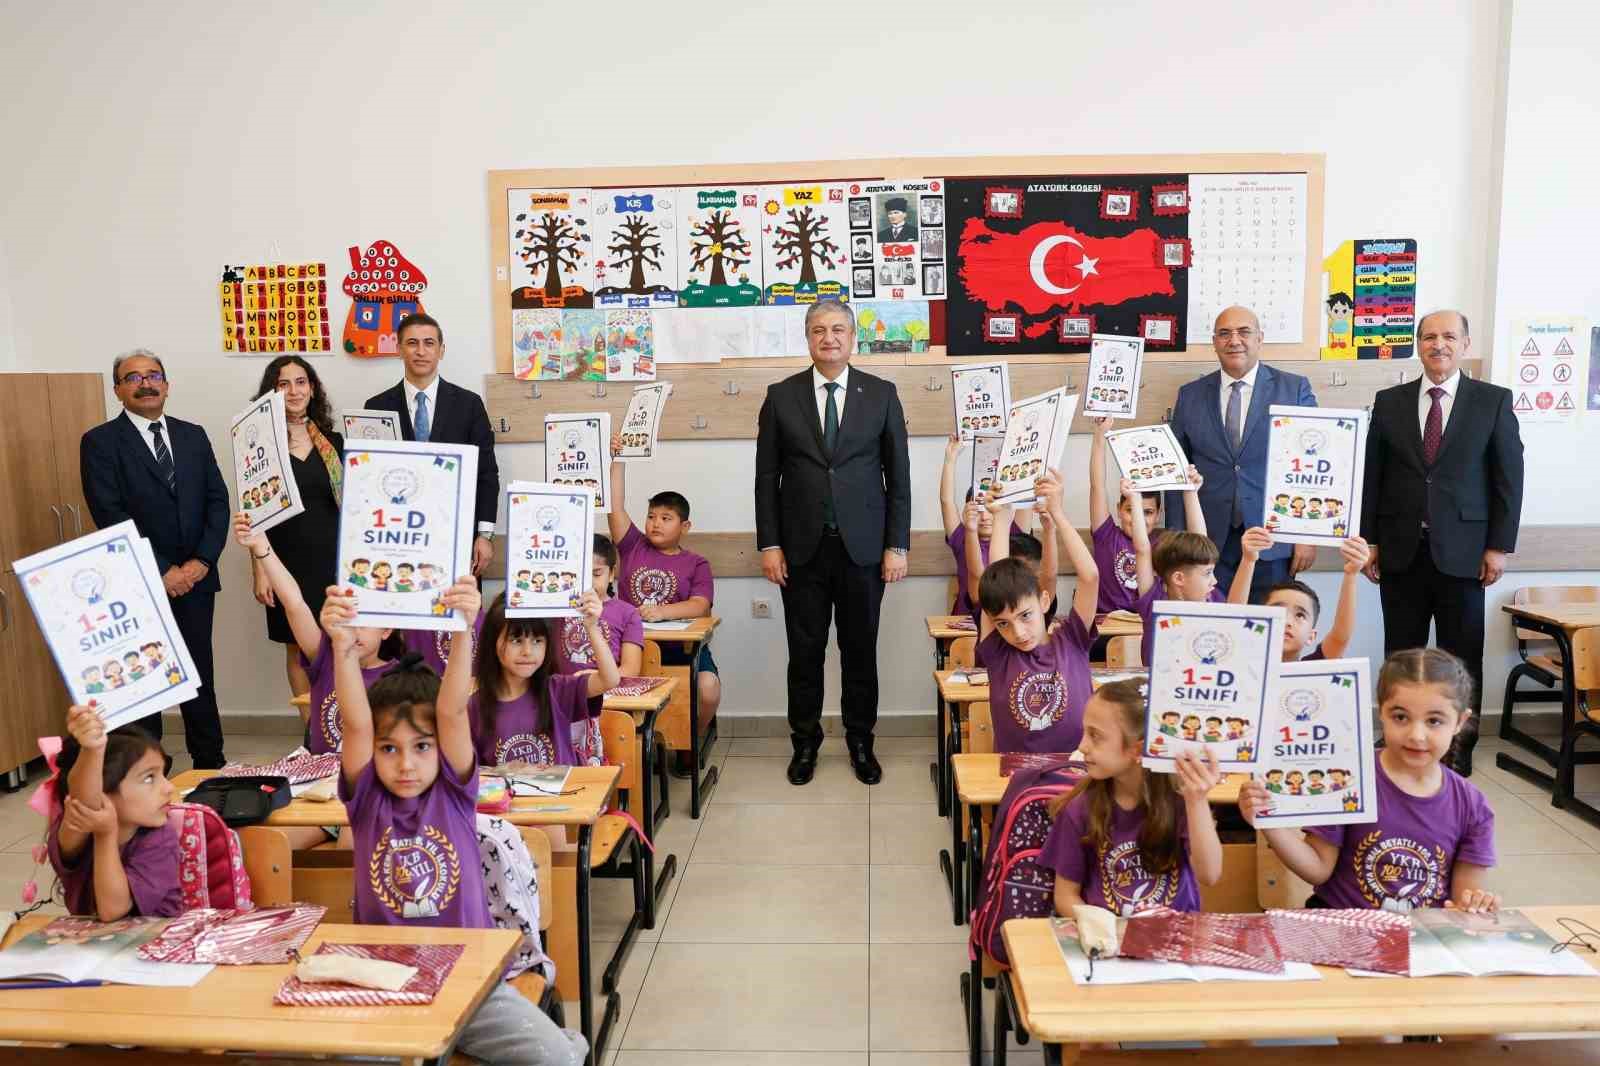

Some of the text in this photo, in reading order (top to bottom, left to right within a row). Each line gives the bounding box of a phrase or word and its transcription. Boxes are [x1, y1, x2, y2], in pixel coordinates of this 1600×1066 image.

[794, 192, 813, 200] YAZ
[626, 199, 642, 208] KIŞ
[249, 268, 256, 277] A
[269, 268, 275, 278] B
[287, 267, 295, 277] C
[224, 285, 231, 294] D
[248, 285, 254, 294] E
[270, 285, 276, 294] F
[287, 283, 296, 293] G
[224, 298, 231, 308] H
[287, 296, 292, 306] J
[308, 297, 315, 306] K
[225, 312, 232, 322] L
[247, 312, 256, 322] M
[269, 312, 277, 321] N
[287, 311, 296, 321] O
[227, 327, 232, 336] P
[249, 326, 255, 336] R
[270, 325, 276, 335] S
[309, 325, 316, 334] T
[226, 340, 232, 350] U
[269, 342, 276, 351] V
[290, 339, 296, 349] Y
[311, 339, 318, 350] Z
[1102, 366, 1123, 375] 1-D
[1098, 374, 1124, 383] SINIFI
[968, 393, 990, 403] 1-D
[965, 402, 994, 410] SINIFI
[632, 410, 647, 420] 1-D
[628, 420, 647, 428] SINIFI
[1015, 432, 1039, 446] 1-D
[1010, 442, 1039, 456] SINIFI
[1131, 446, 1159, 458] 1-D
[244, 446, 265, 468] 1-D
[560, 451, 586, 462] 1-D
[1130, 452, 1164, 464] SINIFI
[243, 459, 270, 481] SINIFI
[557, 462, 589, 472] SINIFI
[1291, 458, 1331, 473] 1-D
[1285, 473, 1334, 487] SINIFI
[372, 509, 425, 529] 1-D
[364, 530, 430, 547] SINIFI
[530, 535, 565, 547] 1-D
[525, 550, 569, 561] SINIFI
[79, 600, 128, 632] 1-D
[79, 617, 140, 652] SINIFI
[1182, 668, 1235, 687] 1-D
[1174, 687, 1238, 702] SINIFI
[1280, 725, 1330, 743] 1-D
[511, 744, 533, 756] YKB
[1274, 743, 1335, 757] SINIFI
[411, 861, 434, 877] YIL
[1407, 869, 1426, 881] YIL
